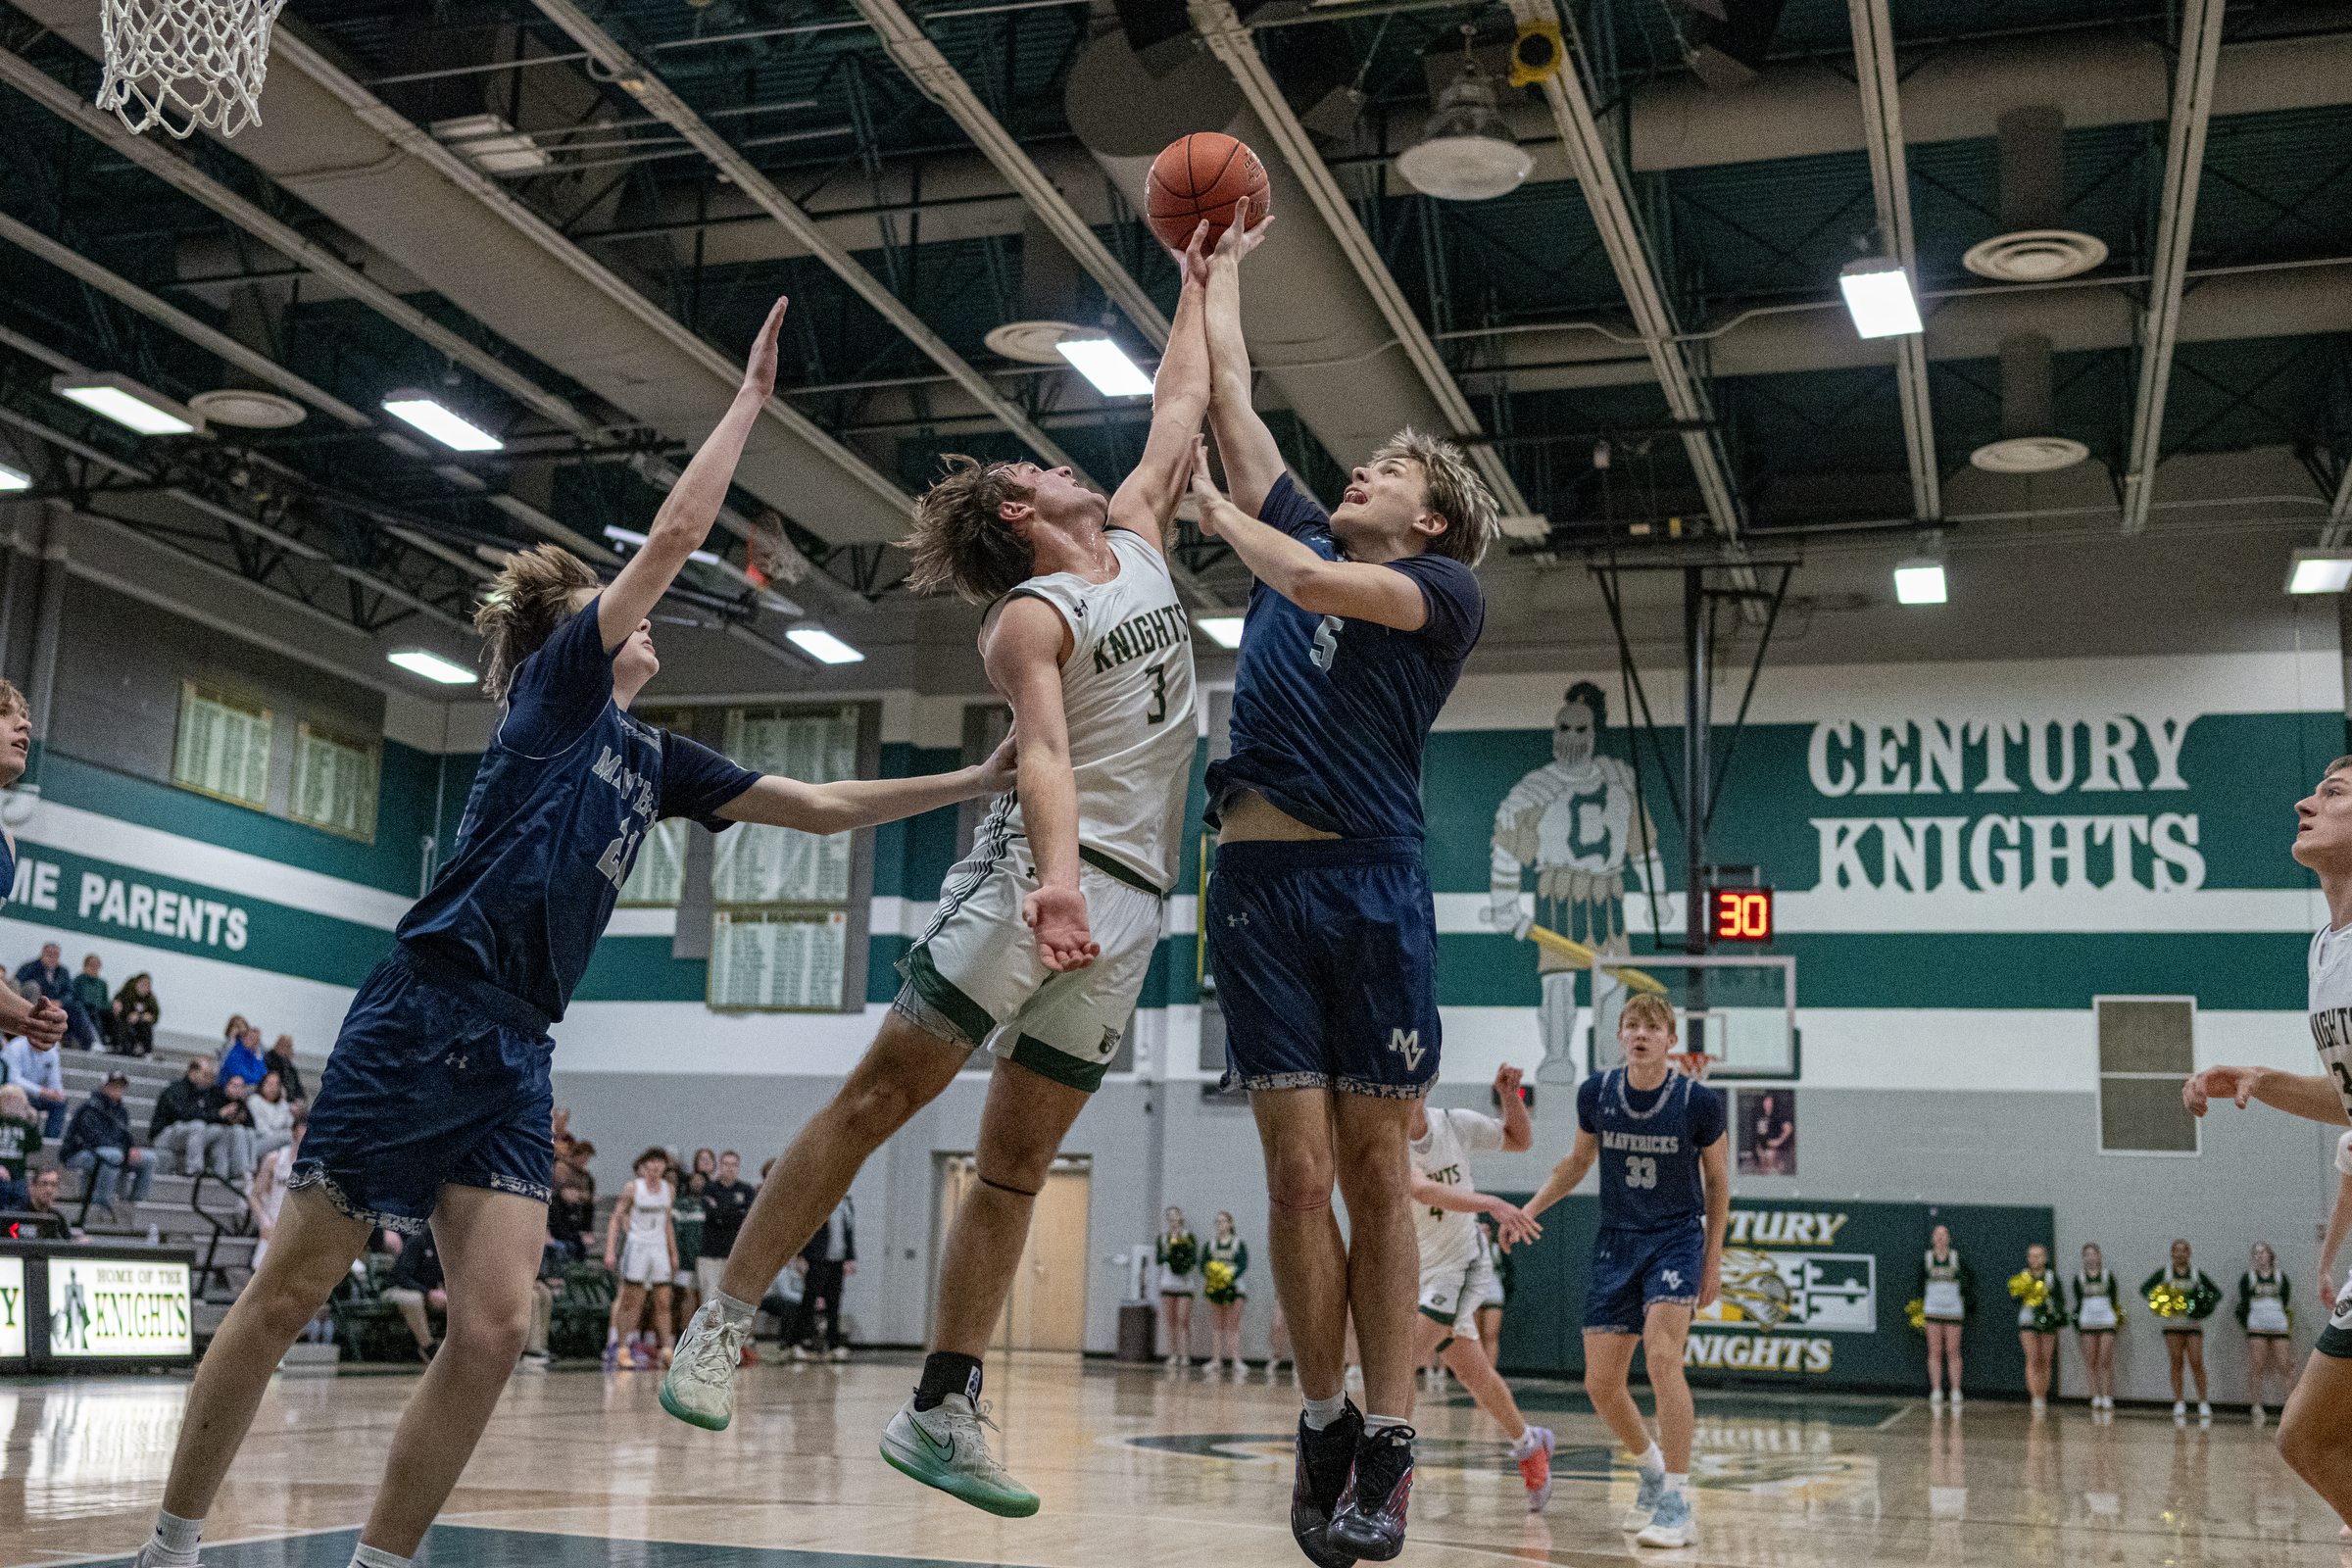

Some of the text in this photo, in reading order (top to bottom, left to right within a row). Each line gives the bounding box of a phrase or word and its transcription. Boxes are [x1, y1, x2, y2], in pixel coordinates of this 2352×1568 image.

[1092, 603, 1189, 675] KNIGHTS
[1144, 662, 1167, 726] 3
[1808, 713, 2201, 798] CENTURY
[1567, 783, 1612, 865] C
[1808, 812, 2206, 893] KNIGHTS
[8, 857, 249, 952] ME PARENTS
[1719, 893, 1768, 938] 30
[1387, 1027, 1427, 1072] MV
[1601, 1130, 1680, 1154] MAVERICKS
[1625, 1154, 1658, 1190] 33
[1729, 1209, 1849, 1246] TURY
[96, 1268, 182, 1286] HOME OF THE
[94, 1291, 188, 1341] KNIGHTS
[1683, 1333, 1834, 1373] NIGHTS
